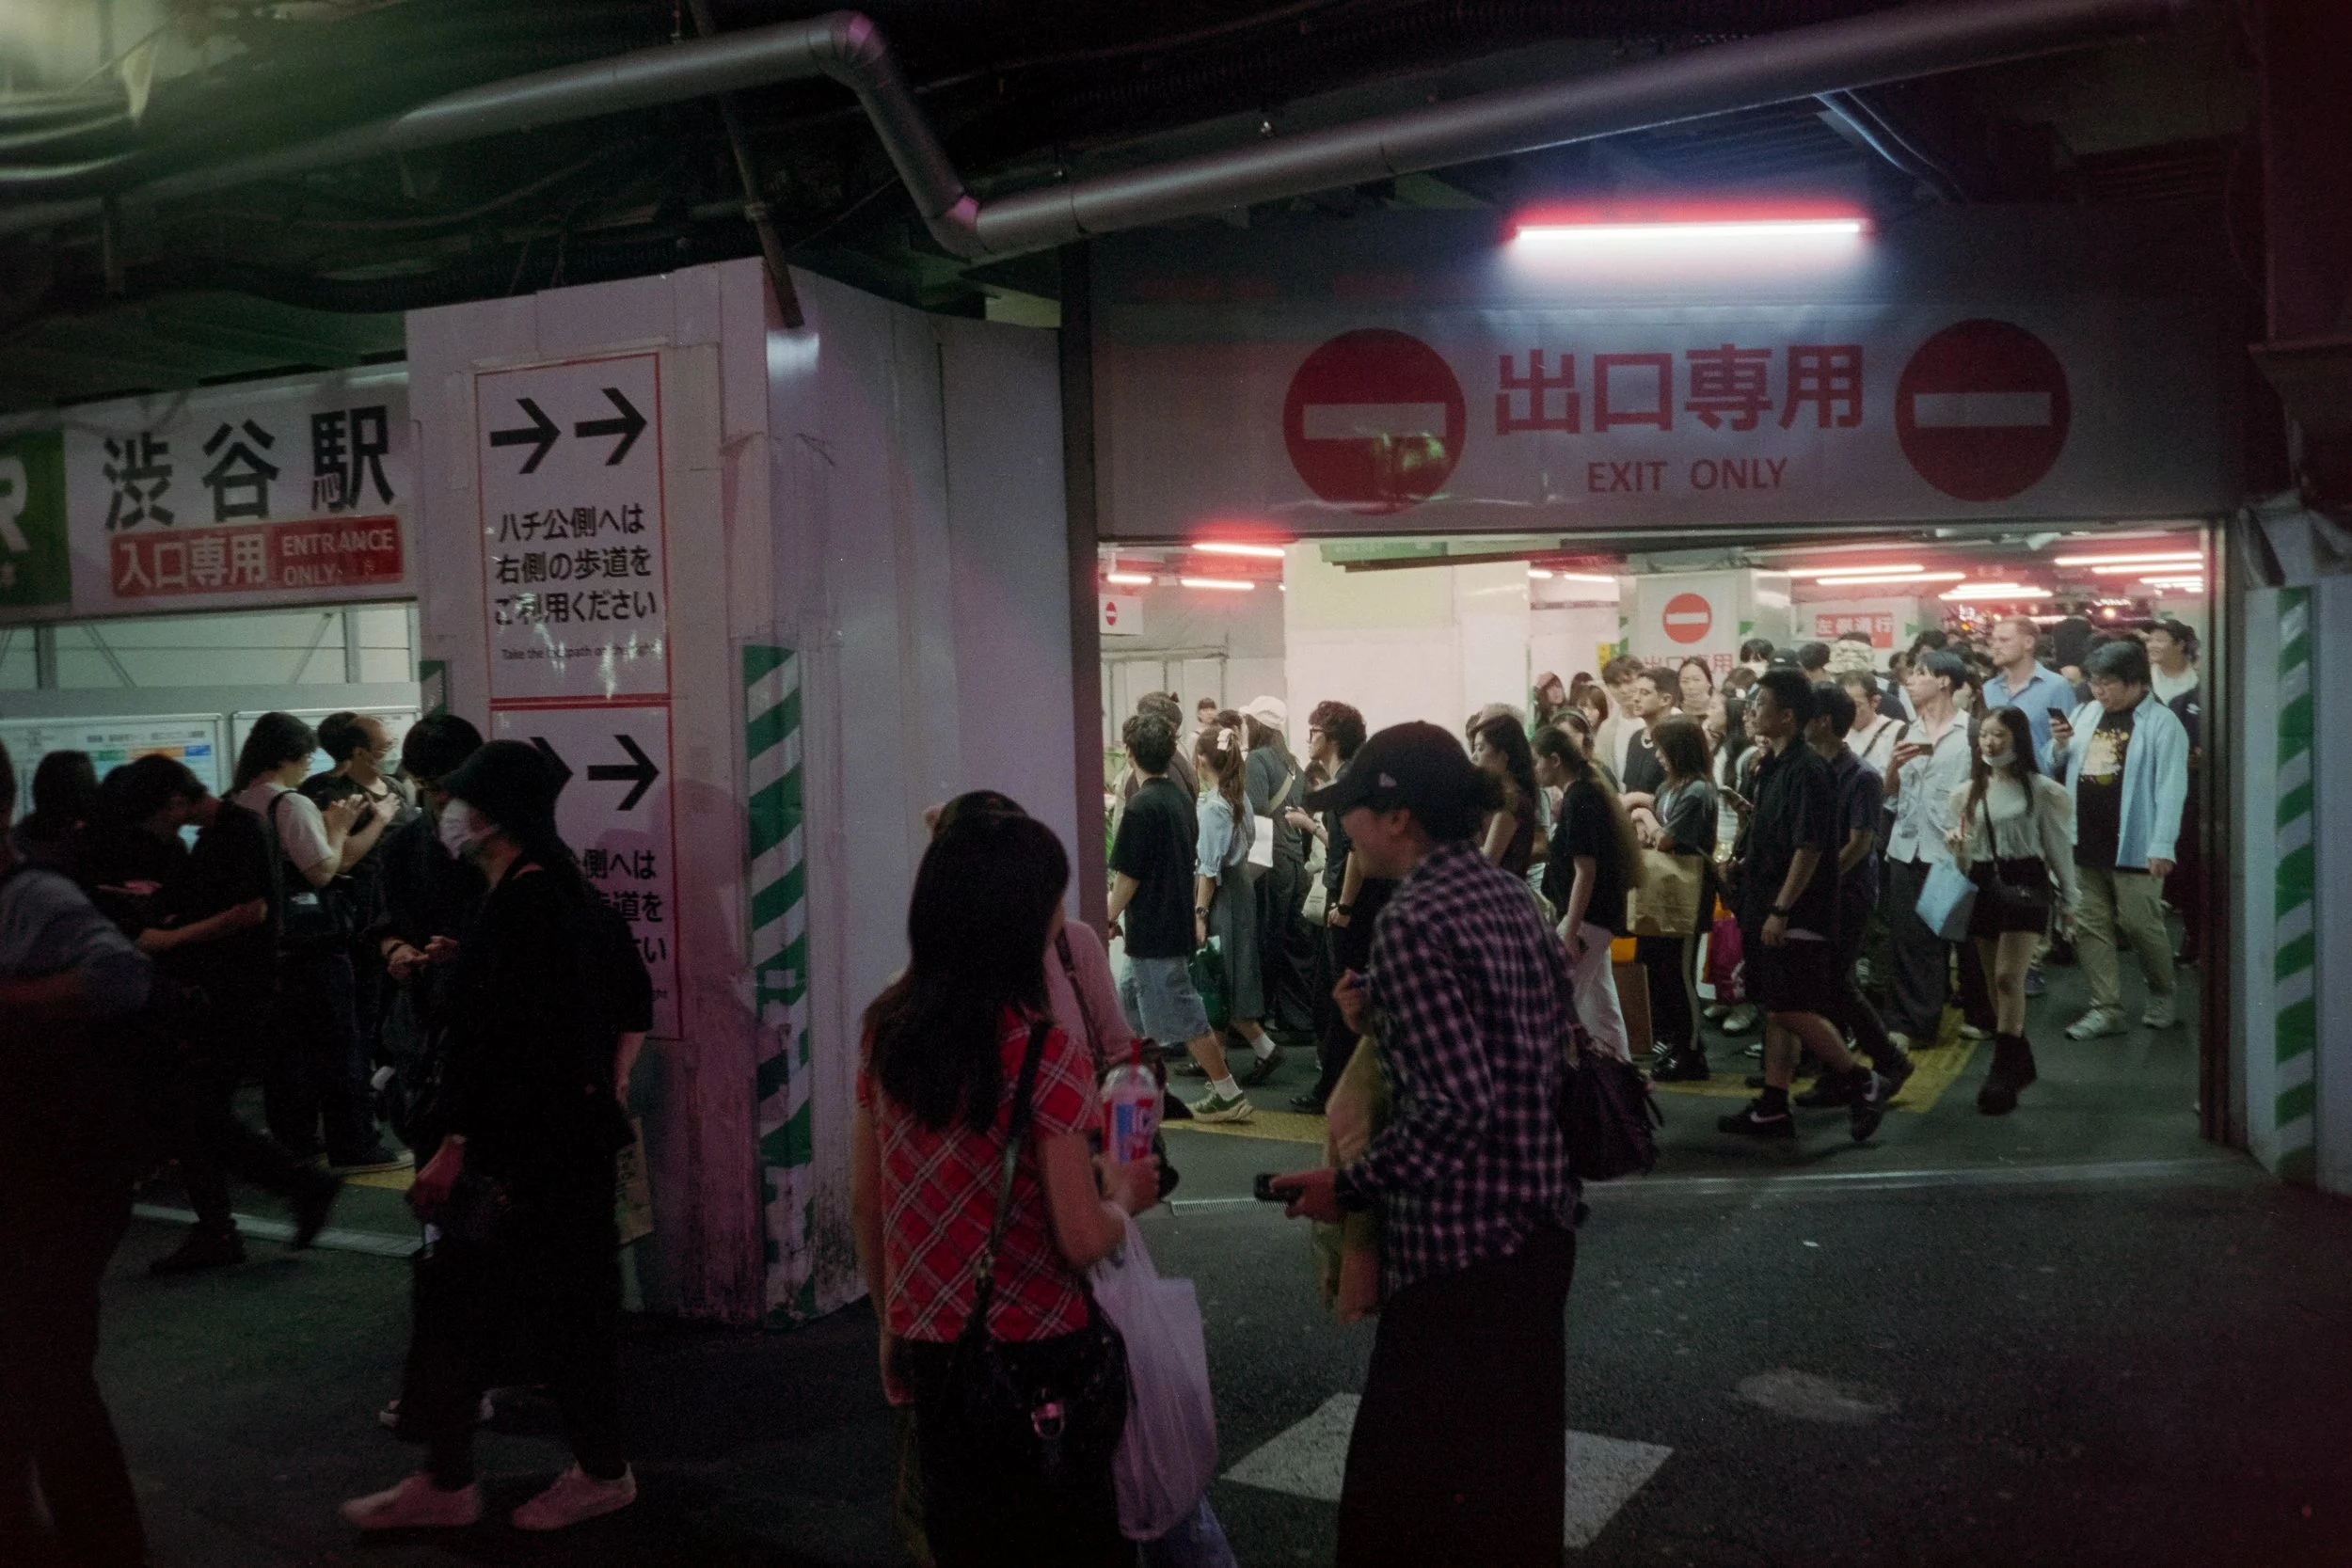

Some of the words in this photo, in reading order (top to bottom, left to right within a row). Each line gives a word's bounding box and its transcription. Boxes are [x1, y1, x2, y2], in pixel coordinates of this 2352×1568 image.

[1495, 342, 1864, 436] 出口専用
[103, 404, 395, 531] 渋谷駅
[1587, 461, 1668, 493] EXIT
[1690, 457, 1788, 491] ONLY
[499, 502, 645, 543] ハチ公側へは
[118, 532, 267, 590] 入口専用
[281, 528, 395, 557] ENTRANCE
[283, 562, 337, 586] ONLY
[495, 545, 652, 585] 右側の歩道を
[495, 588, 657, 626] ご利用ください
[584, 848, 657, 879] 側へは
